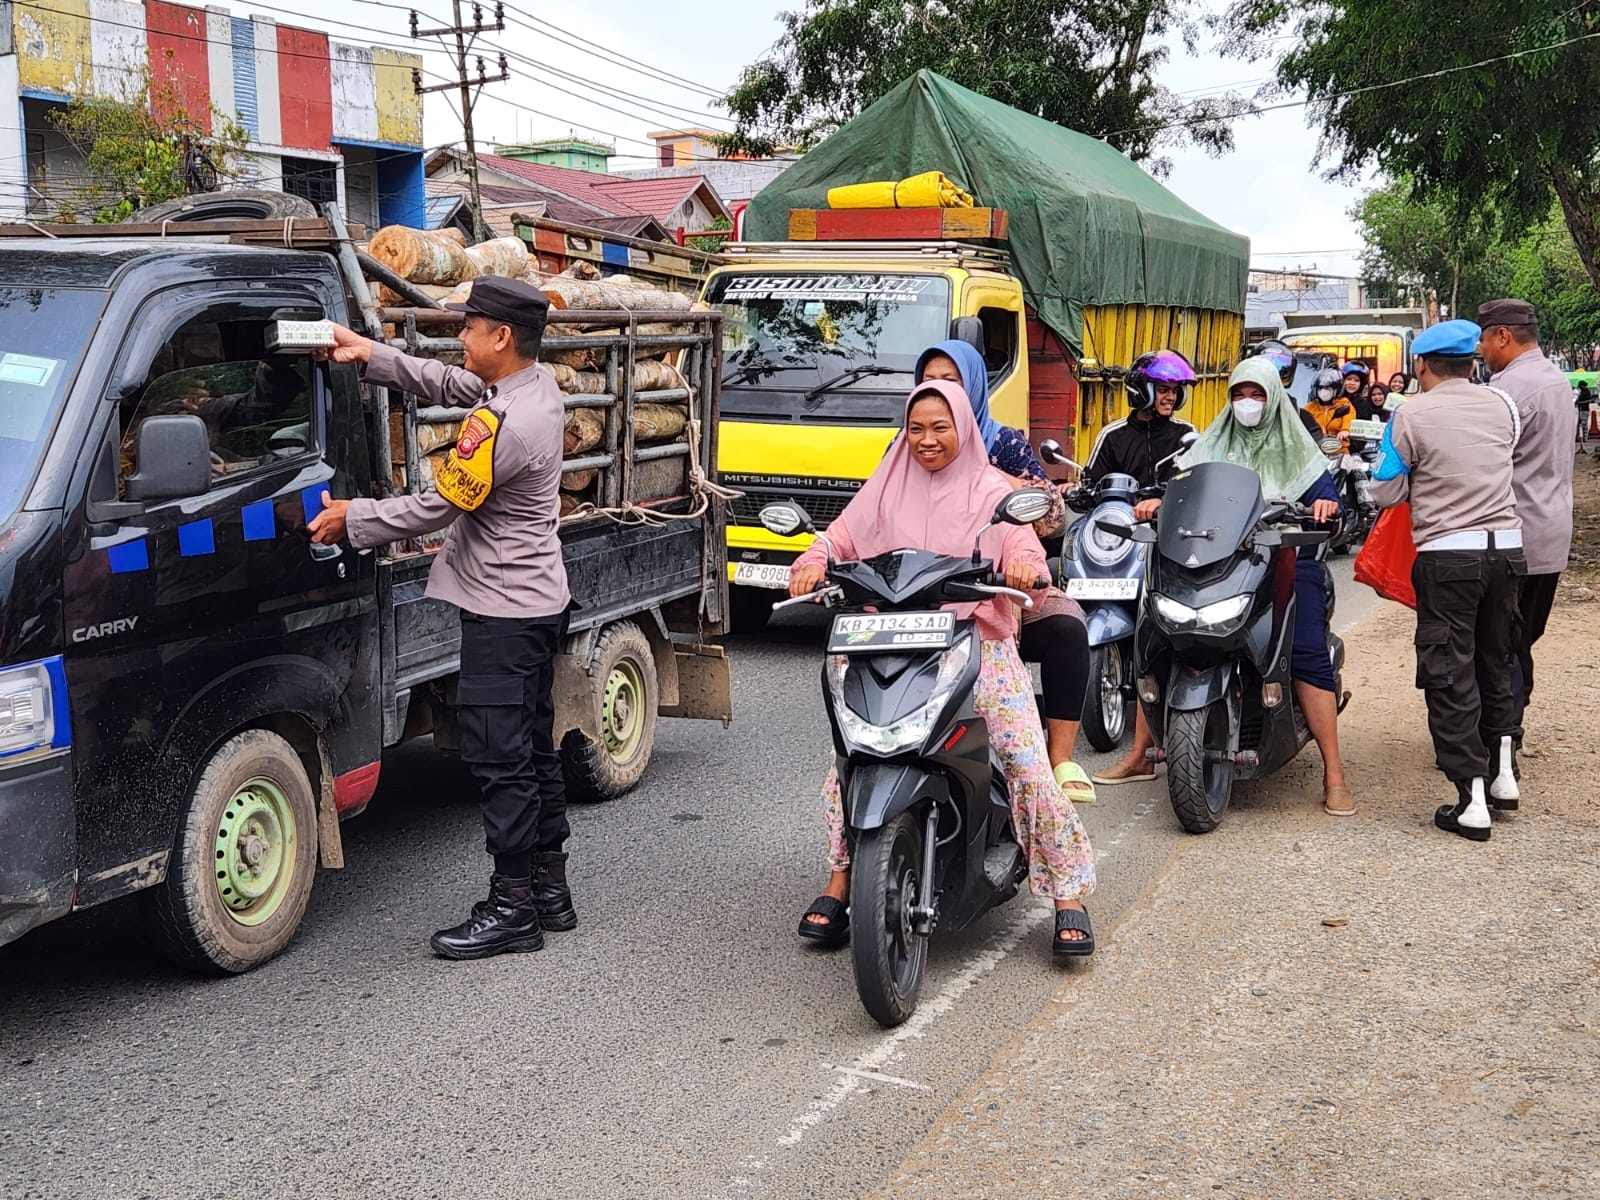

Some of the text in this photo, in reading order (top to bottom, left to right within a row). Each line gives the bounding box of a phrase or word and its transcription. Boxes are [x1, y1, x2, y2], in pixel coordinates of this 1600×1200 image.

[724, 474, 862, 488] MITSUBISHI FUSO
[737, 564, 754, 578] KB
[72, 615, 139, 643] CARRY
[840, 616, 949, 632] KB 2134 SAD
